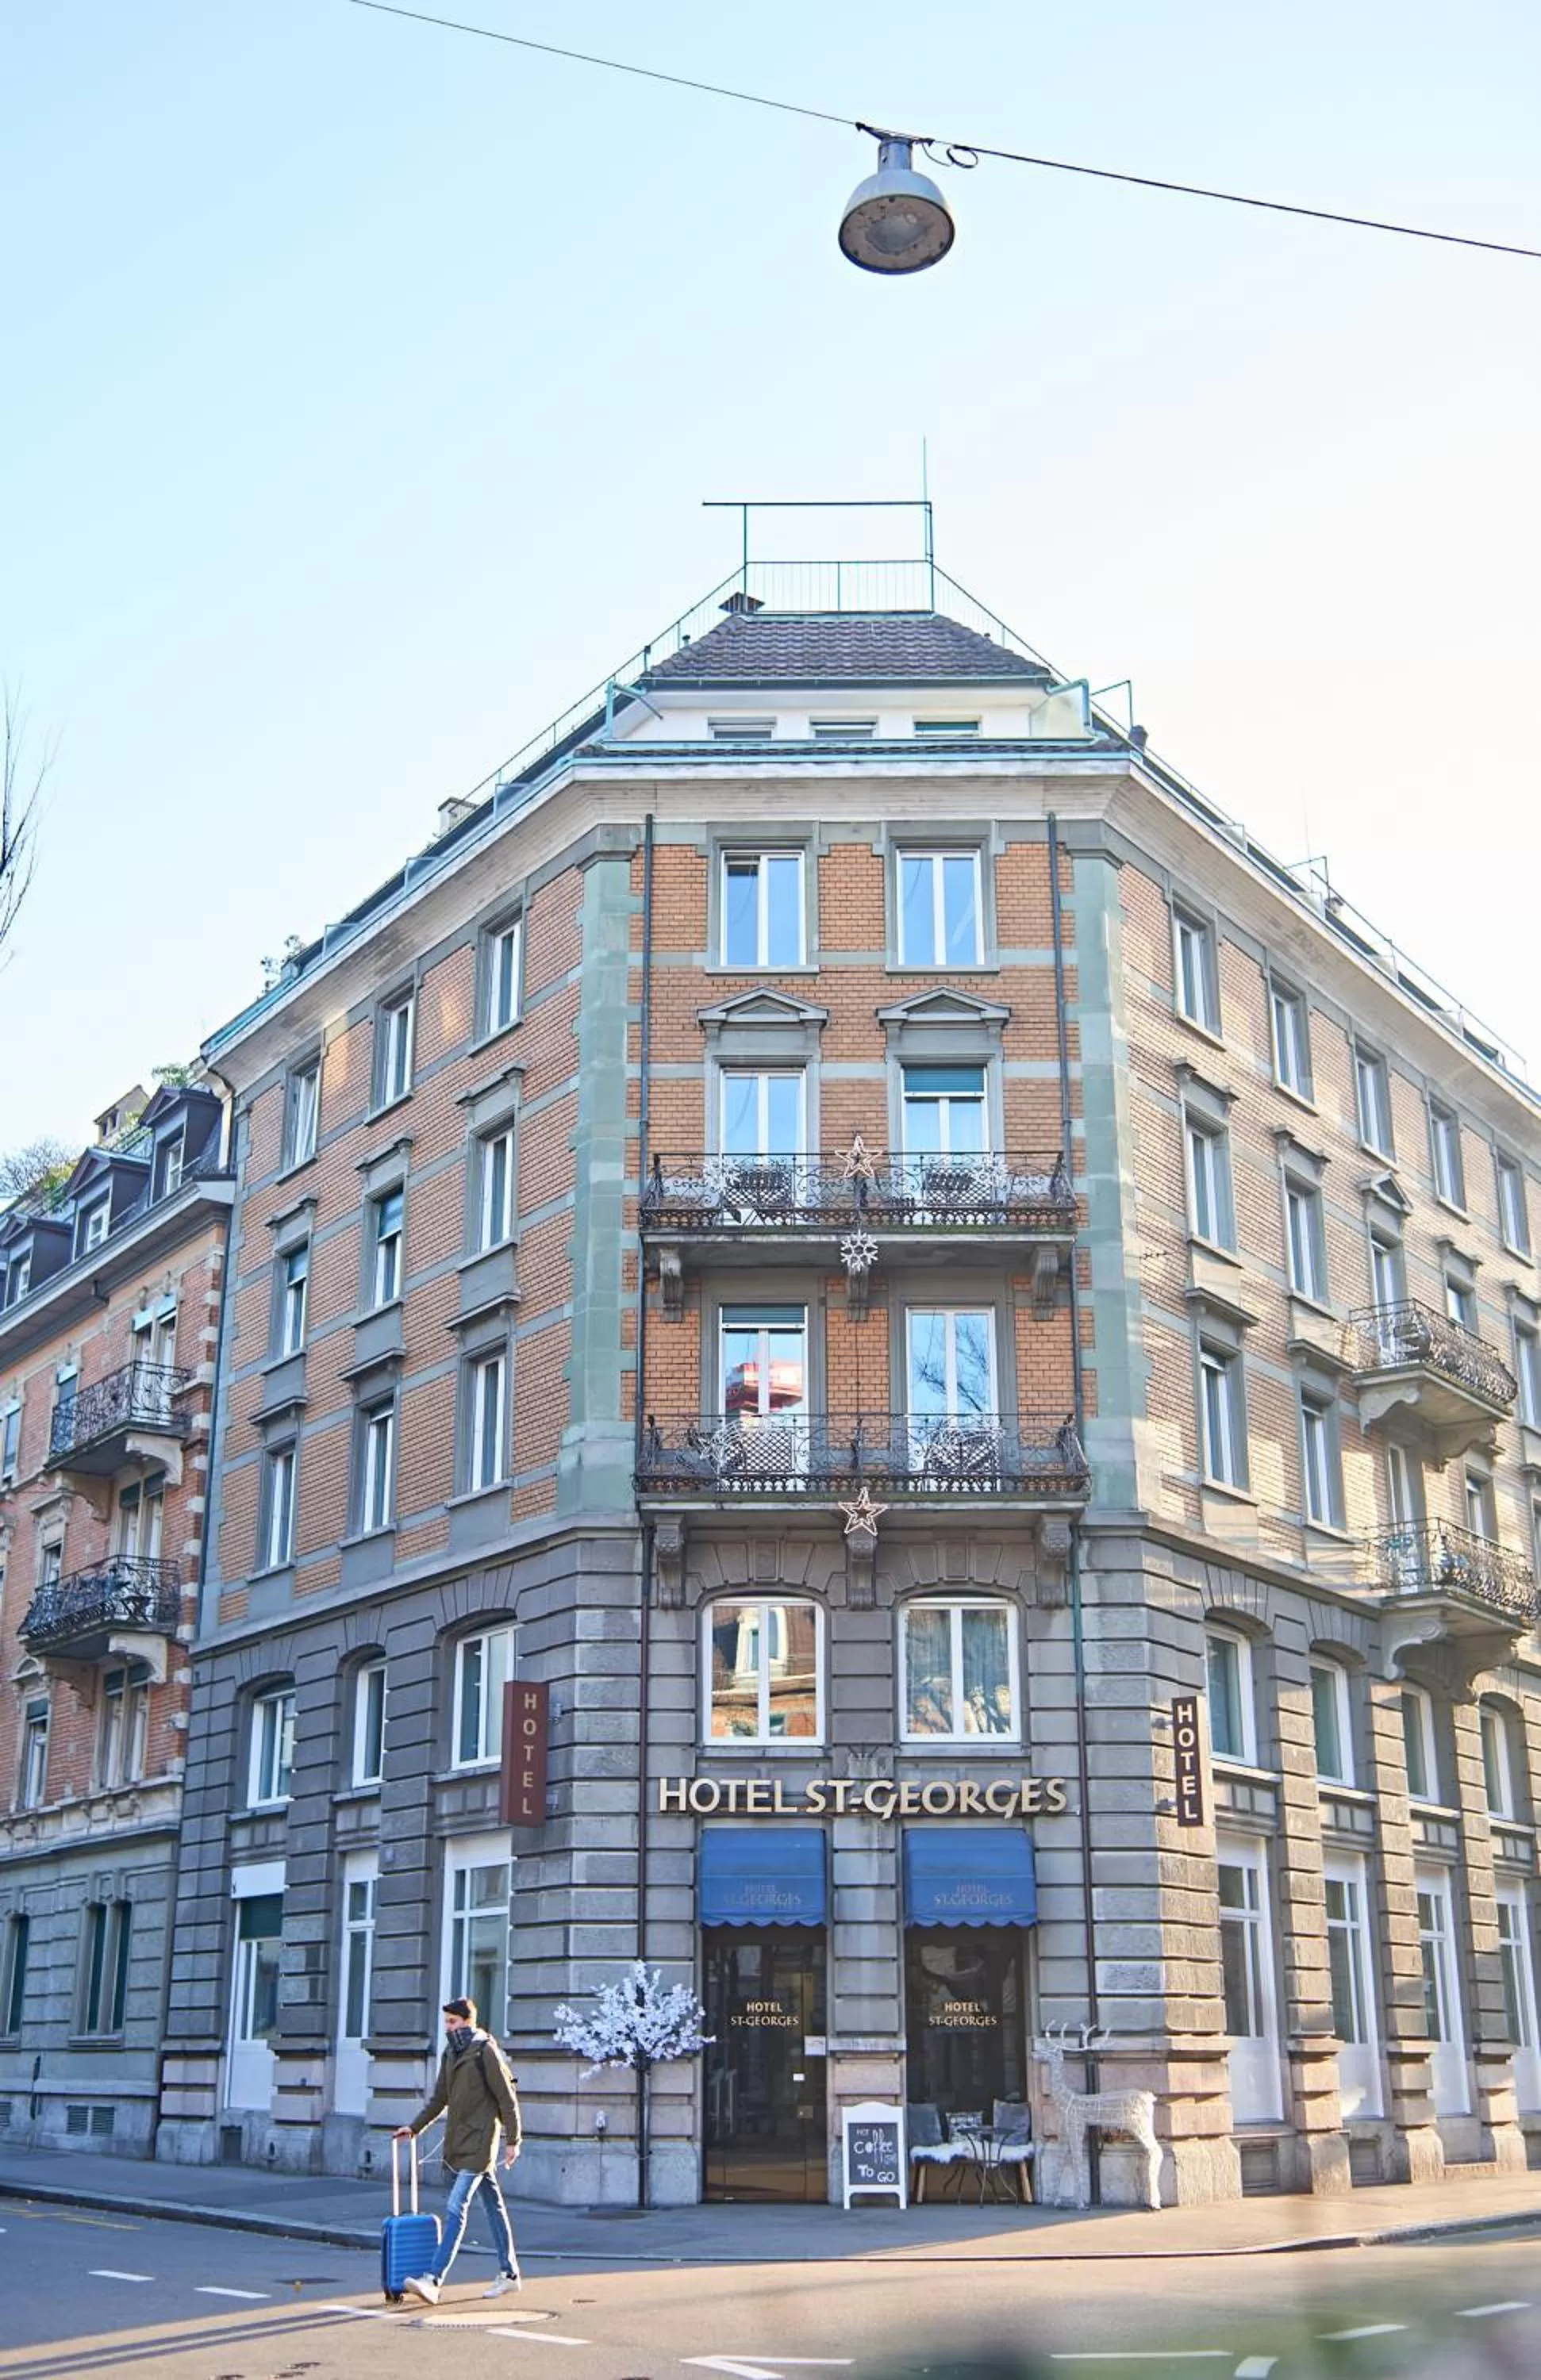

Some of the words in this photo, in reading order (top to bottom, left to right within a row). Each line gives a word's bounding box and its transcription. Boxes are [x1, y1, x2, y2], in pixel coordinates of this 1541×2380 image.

[521, 1692, 537, 1814] HOTEL
[1177, 1703, 1197, 1819] HOTEL
[659, 1778, 797, 1813] HOTEL
[805, 1778, 1066, 1819] ST-GEORGES
[747, 2002, 782, 2013] HOTEL
[944, 2002, 981, 2013] HOTEL
[877, 2171, 896, 2183] GO
